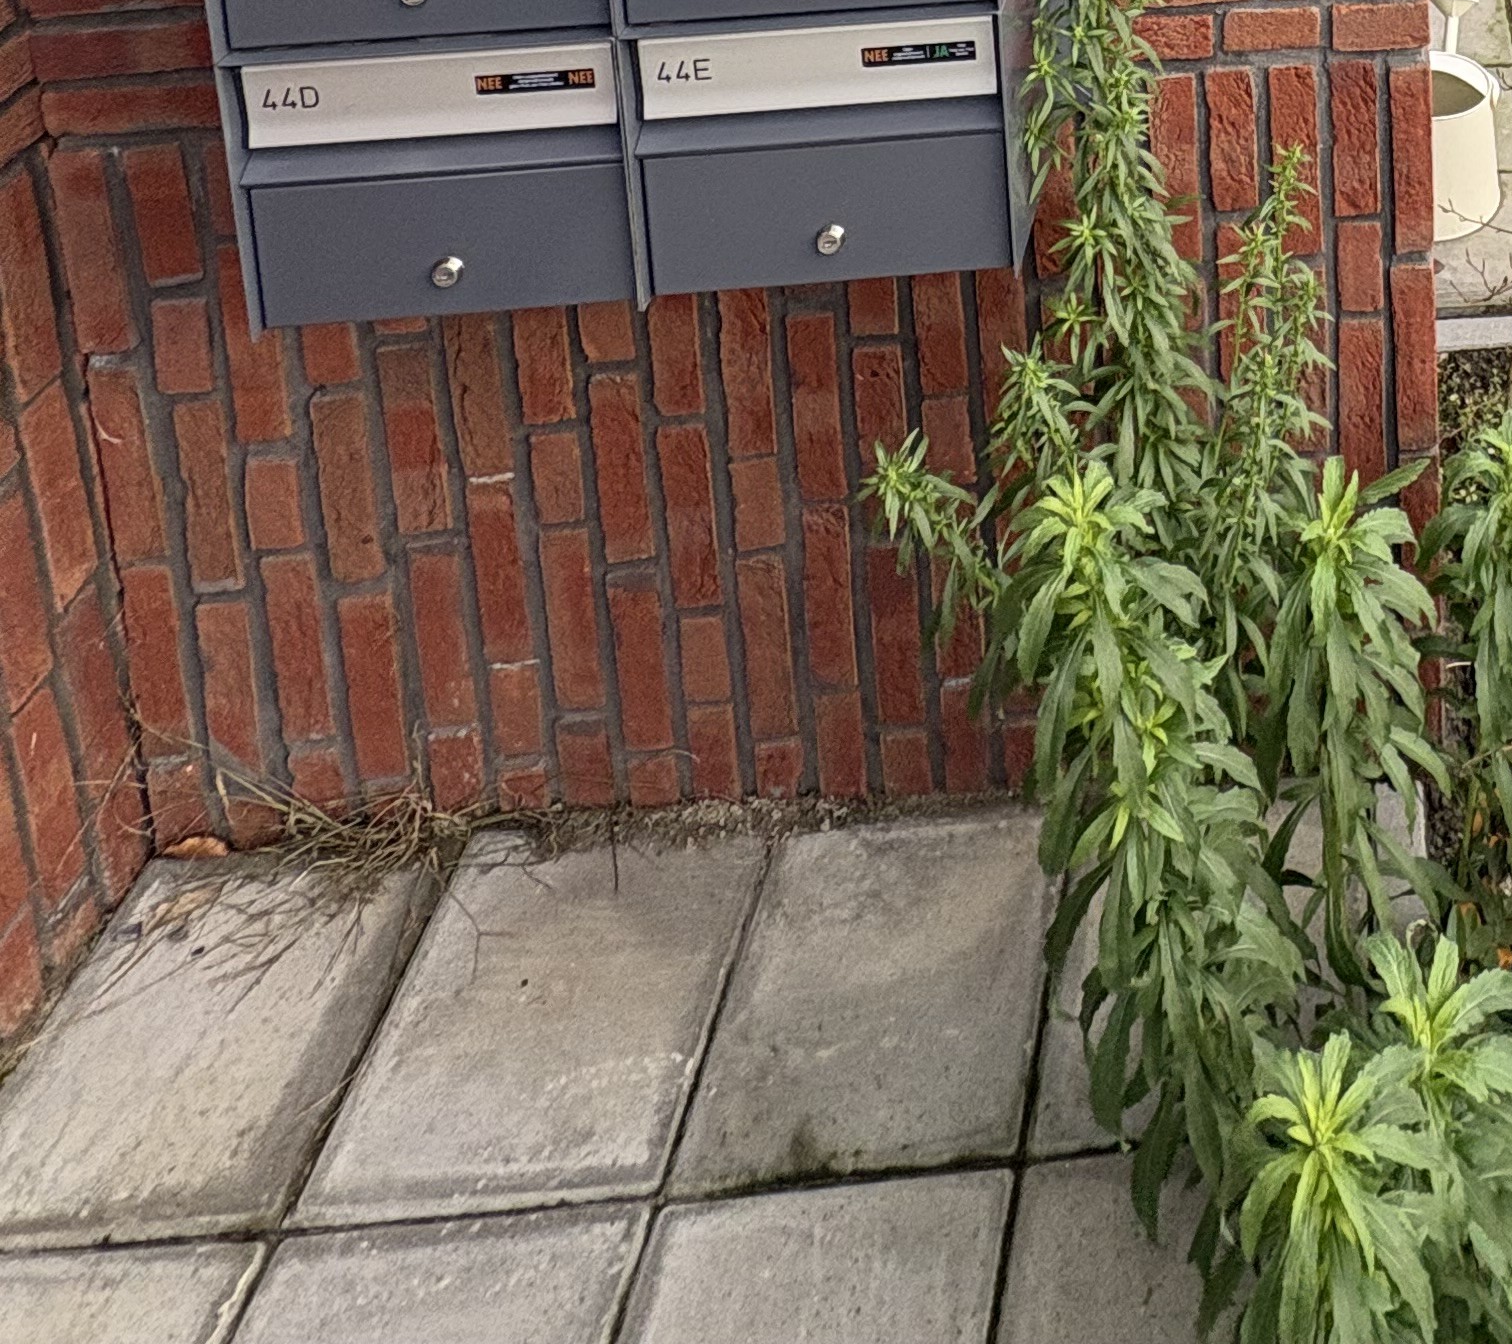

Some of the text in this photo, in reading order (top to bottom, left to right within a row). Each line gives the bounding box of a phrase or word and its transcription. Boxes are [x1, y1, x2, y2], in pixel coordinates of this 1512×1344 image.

[864, 49, 889, 62] NEE
[933, 45, 950, 58] JA
[657, 58, 713, 83] 44E
[477, 77, 503, 91] NEE
[568, 71, 593, 85] NEE
[262, 86, 320, 110] 44D
